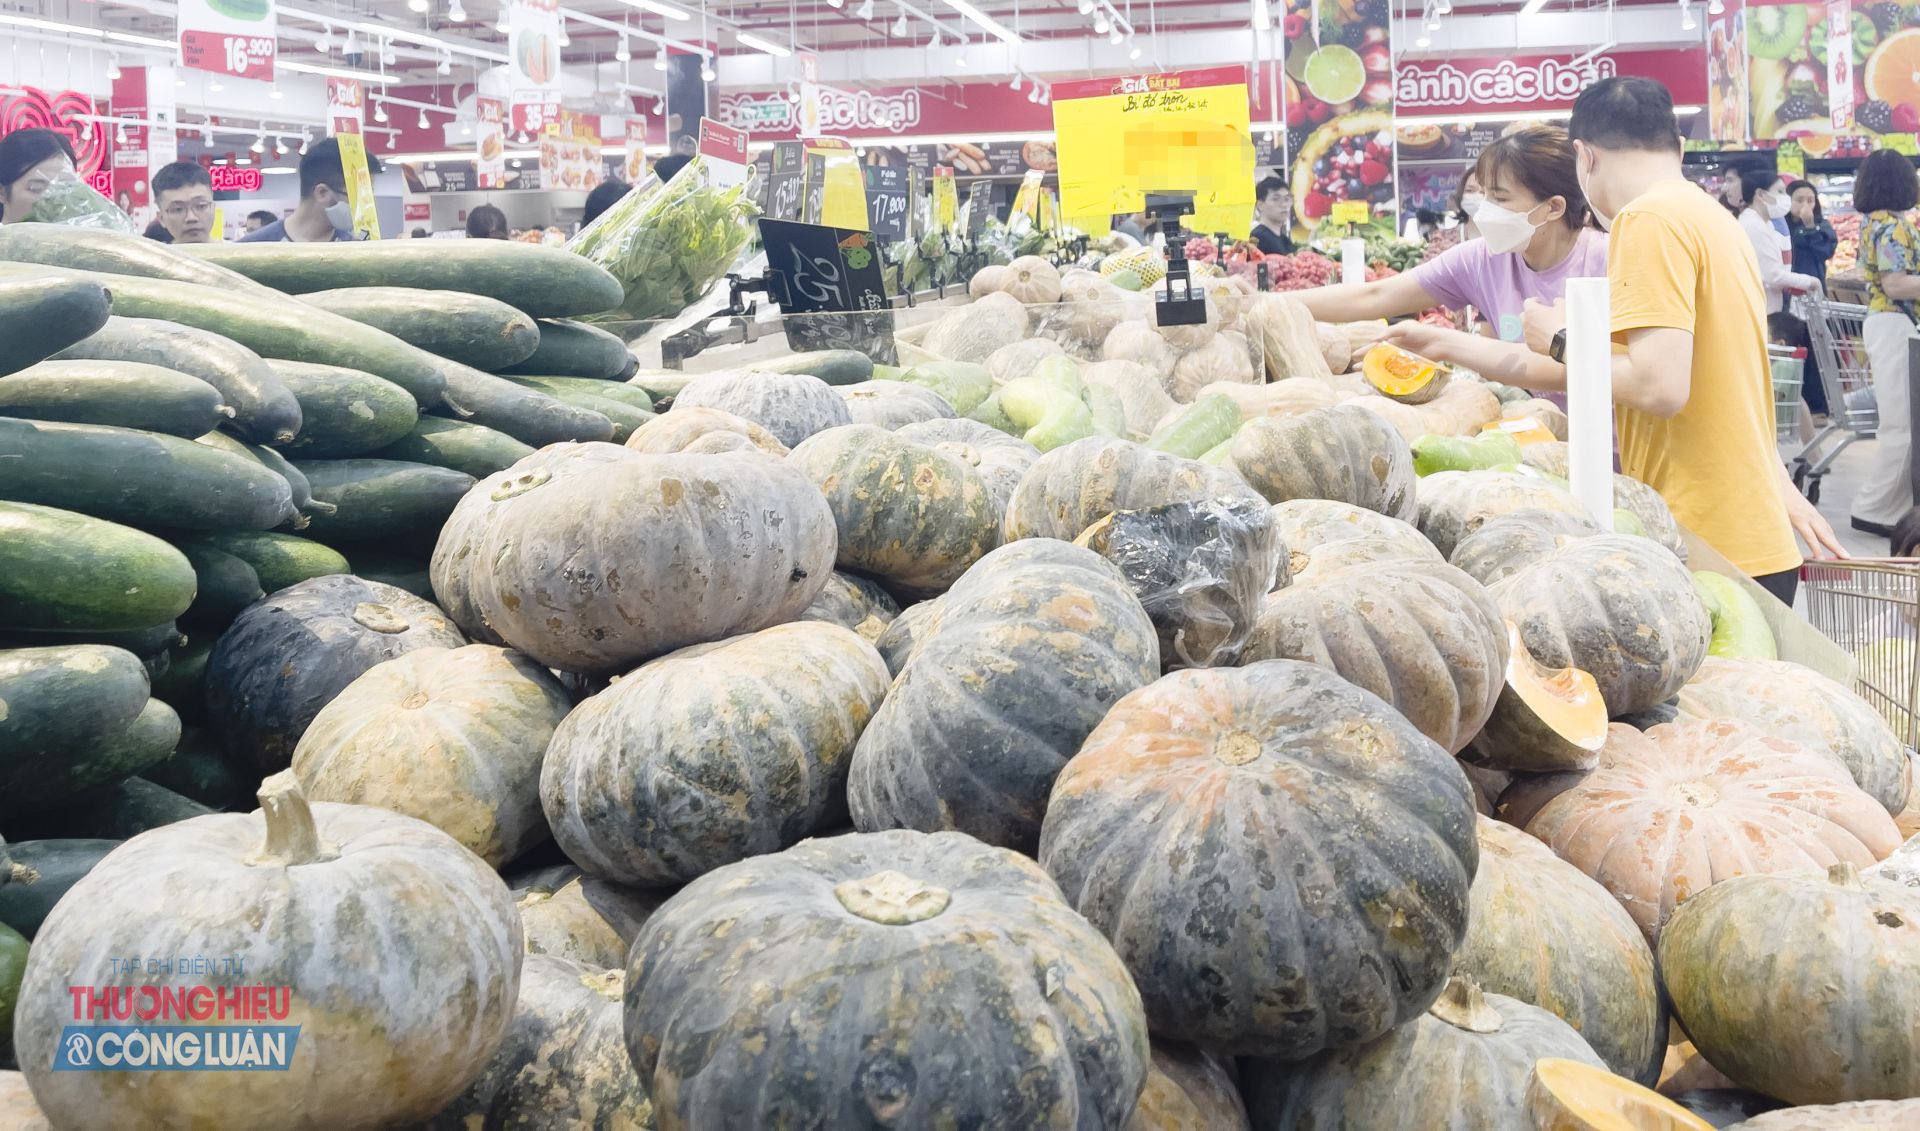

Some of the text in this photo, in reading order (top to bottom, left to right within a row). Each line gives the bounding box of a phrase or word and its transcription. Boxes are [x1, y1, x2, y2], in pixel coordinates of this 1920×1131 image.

[1400, 67, 1463, 100] ánh
[1473, 65, 1537, 98] các
[212, 170, 256, 187] Hàng
